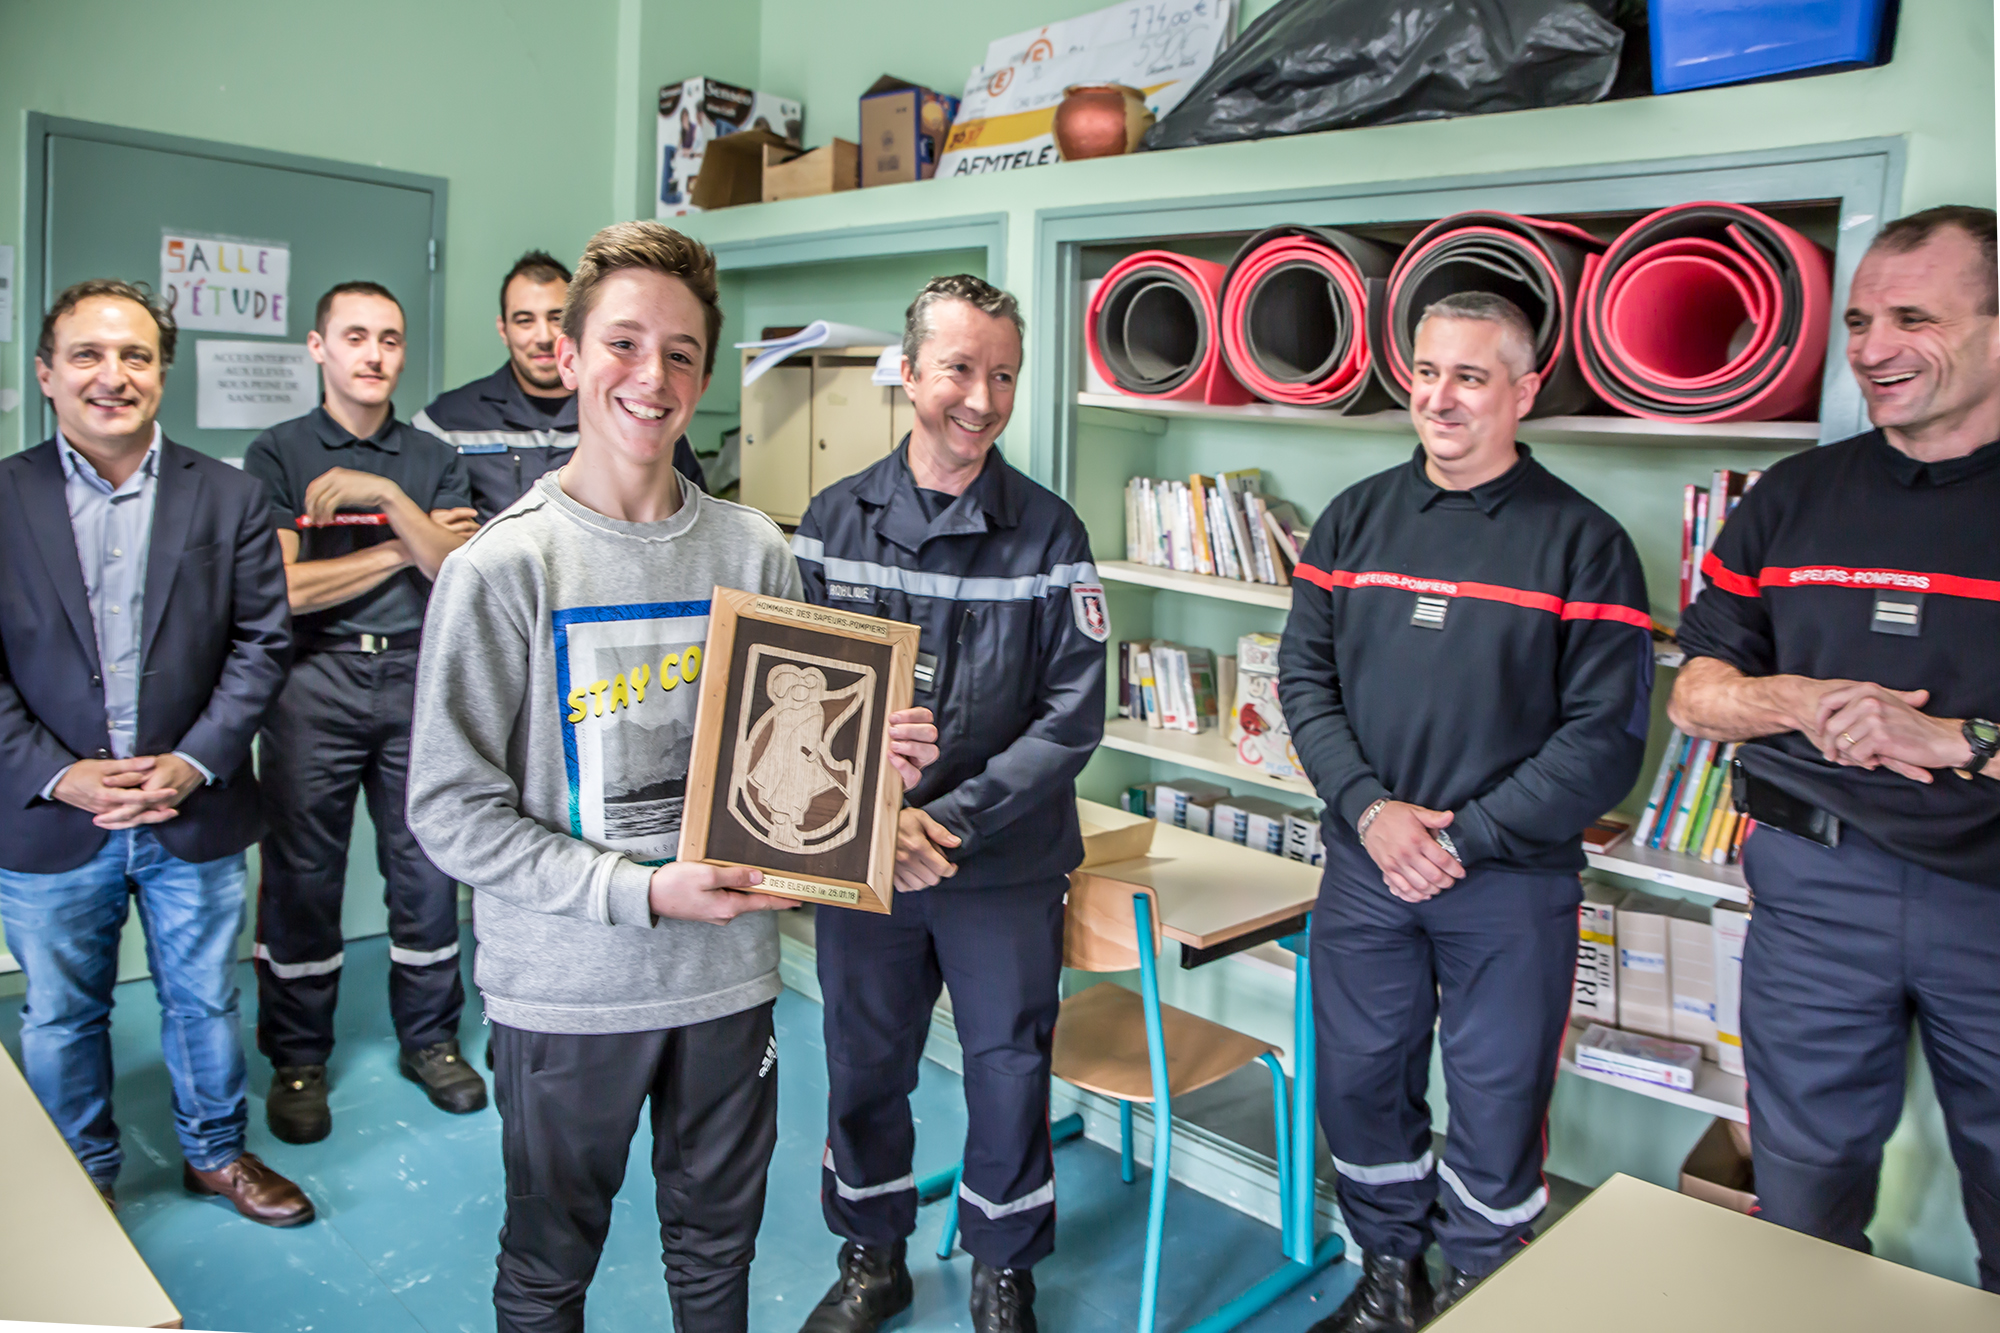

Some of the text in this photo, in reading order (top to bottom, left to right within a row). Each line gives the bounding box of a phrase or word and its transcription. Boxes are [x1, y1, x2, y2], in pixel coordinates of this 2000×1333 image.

[167, 240, 268, 274] SALLE
[756, 600, 887, 635] HOMMAGE DES SAPEURS-POMPIERS
[567, 645, 702, 724] STAY CO
[770, 878, 785, 889] DES
[787, 881, 817, 894] ELEVES
